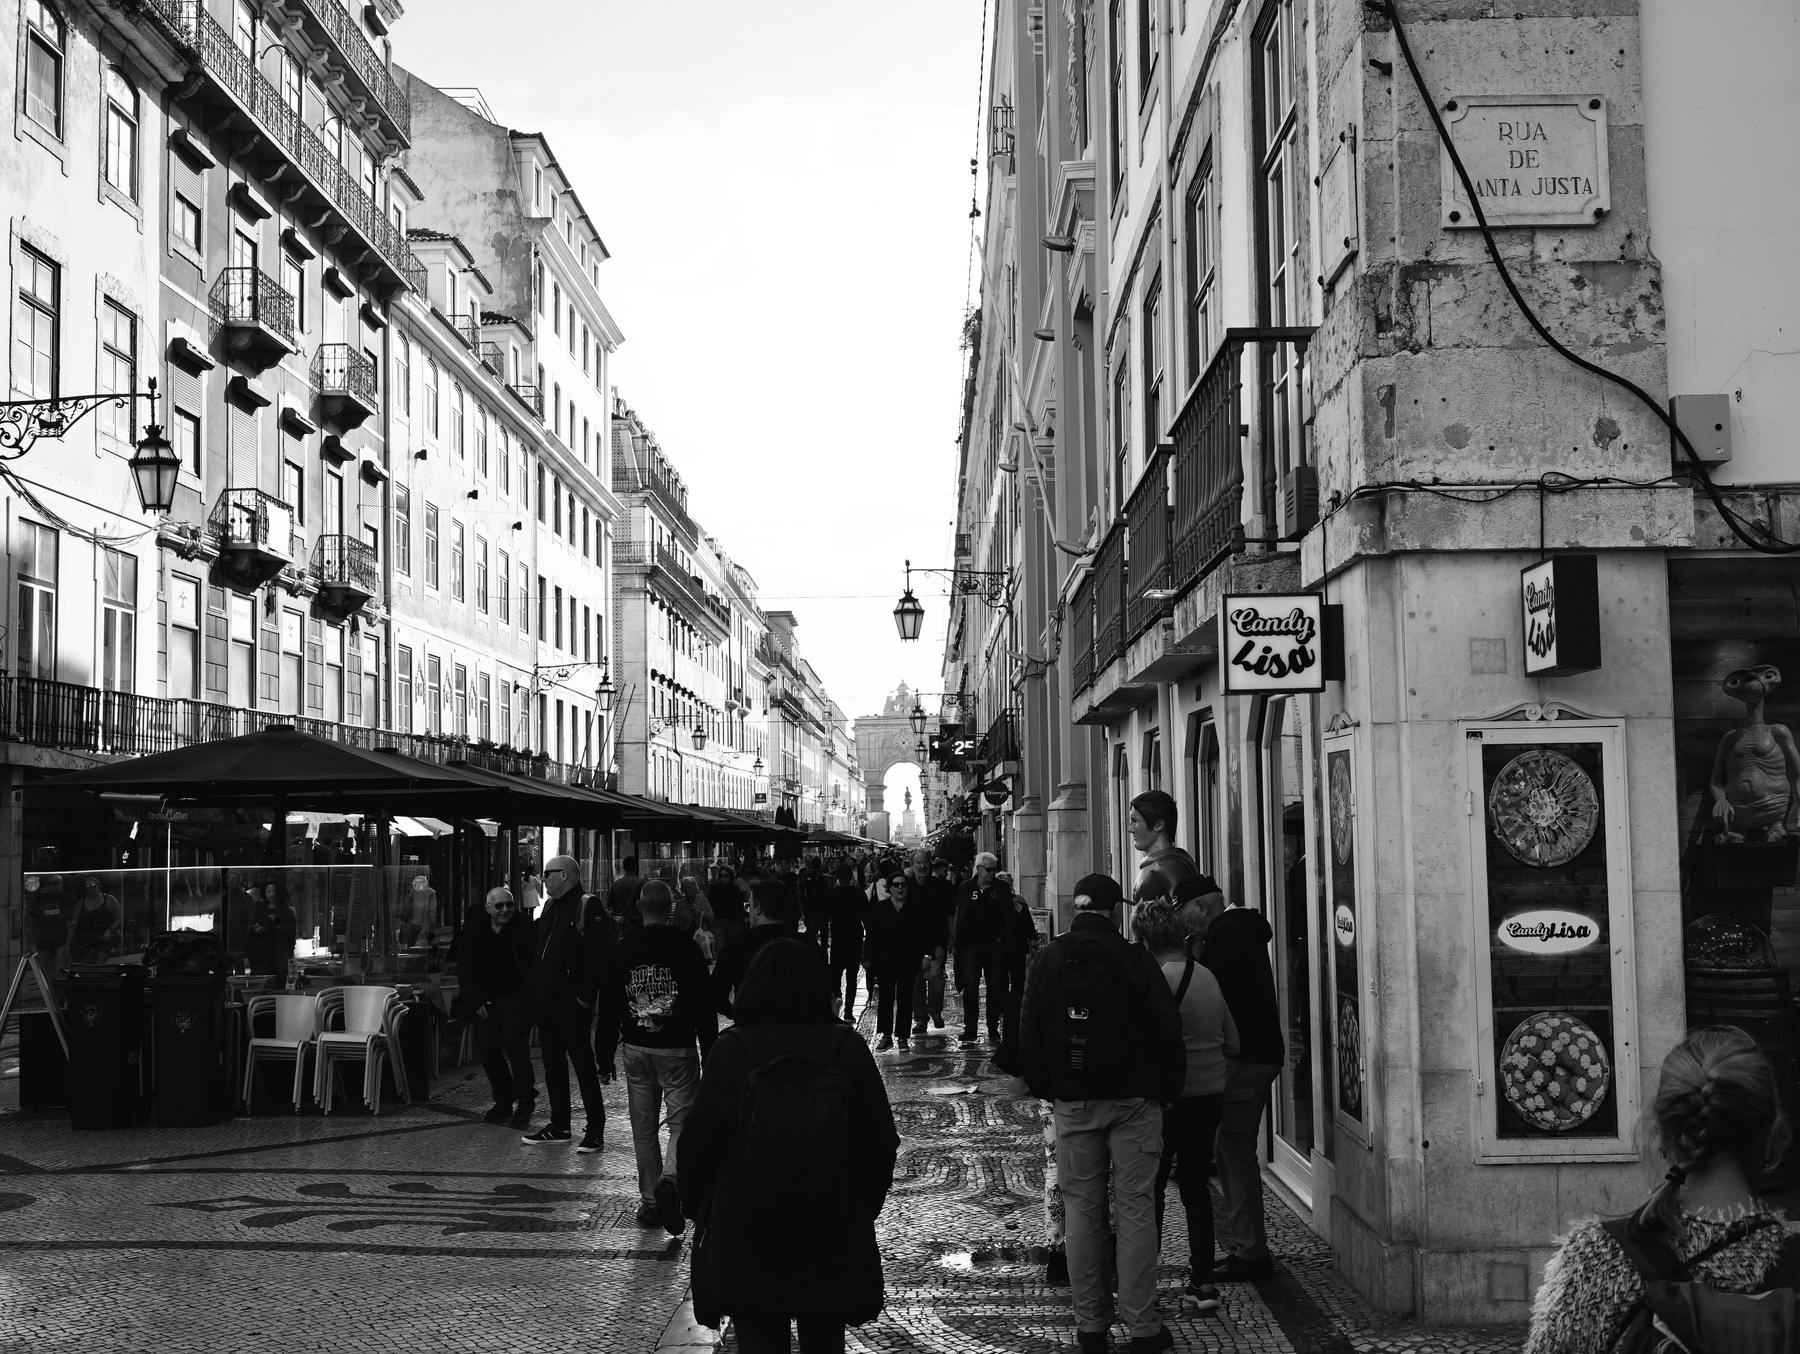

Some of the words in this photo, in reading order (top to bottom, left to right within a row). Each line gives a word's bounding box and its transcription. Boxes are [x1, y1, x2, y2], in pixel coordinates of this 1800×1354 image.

[1498, 121, 1548, 141] RUA
[1509, 149, 1541, 169] DE
[1531, 176, 1594, 195] JUSTA
[1524, 576, 1555, 618] Candy
[1230, 607, 1316, 645] Candy
[1528, 617, 1555, 658] Lisa
[1231, 640, 1316, 679] Lisa
[970, 890, 979, 901] 5
[625, 981, 679, 999] NAZARENE
